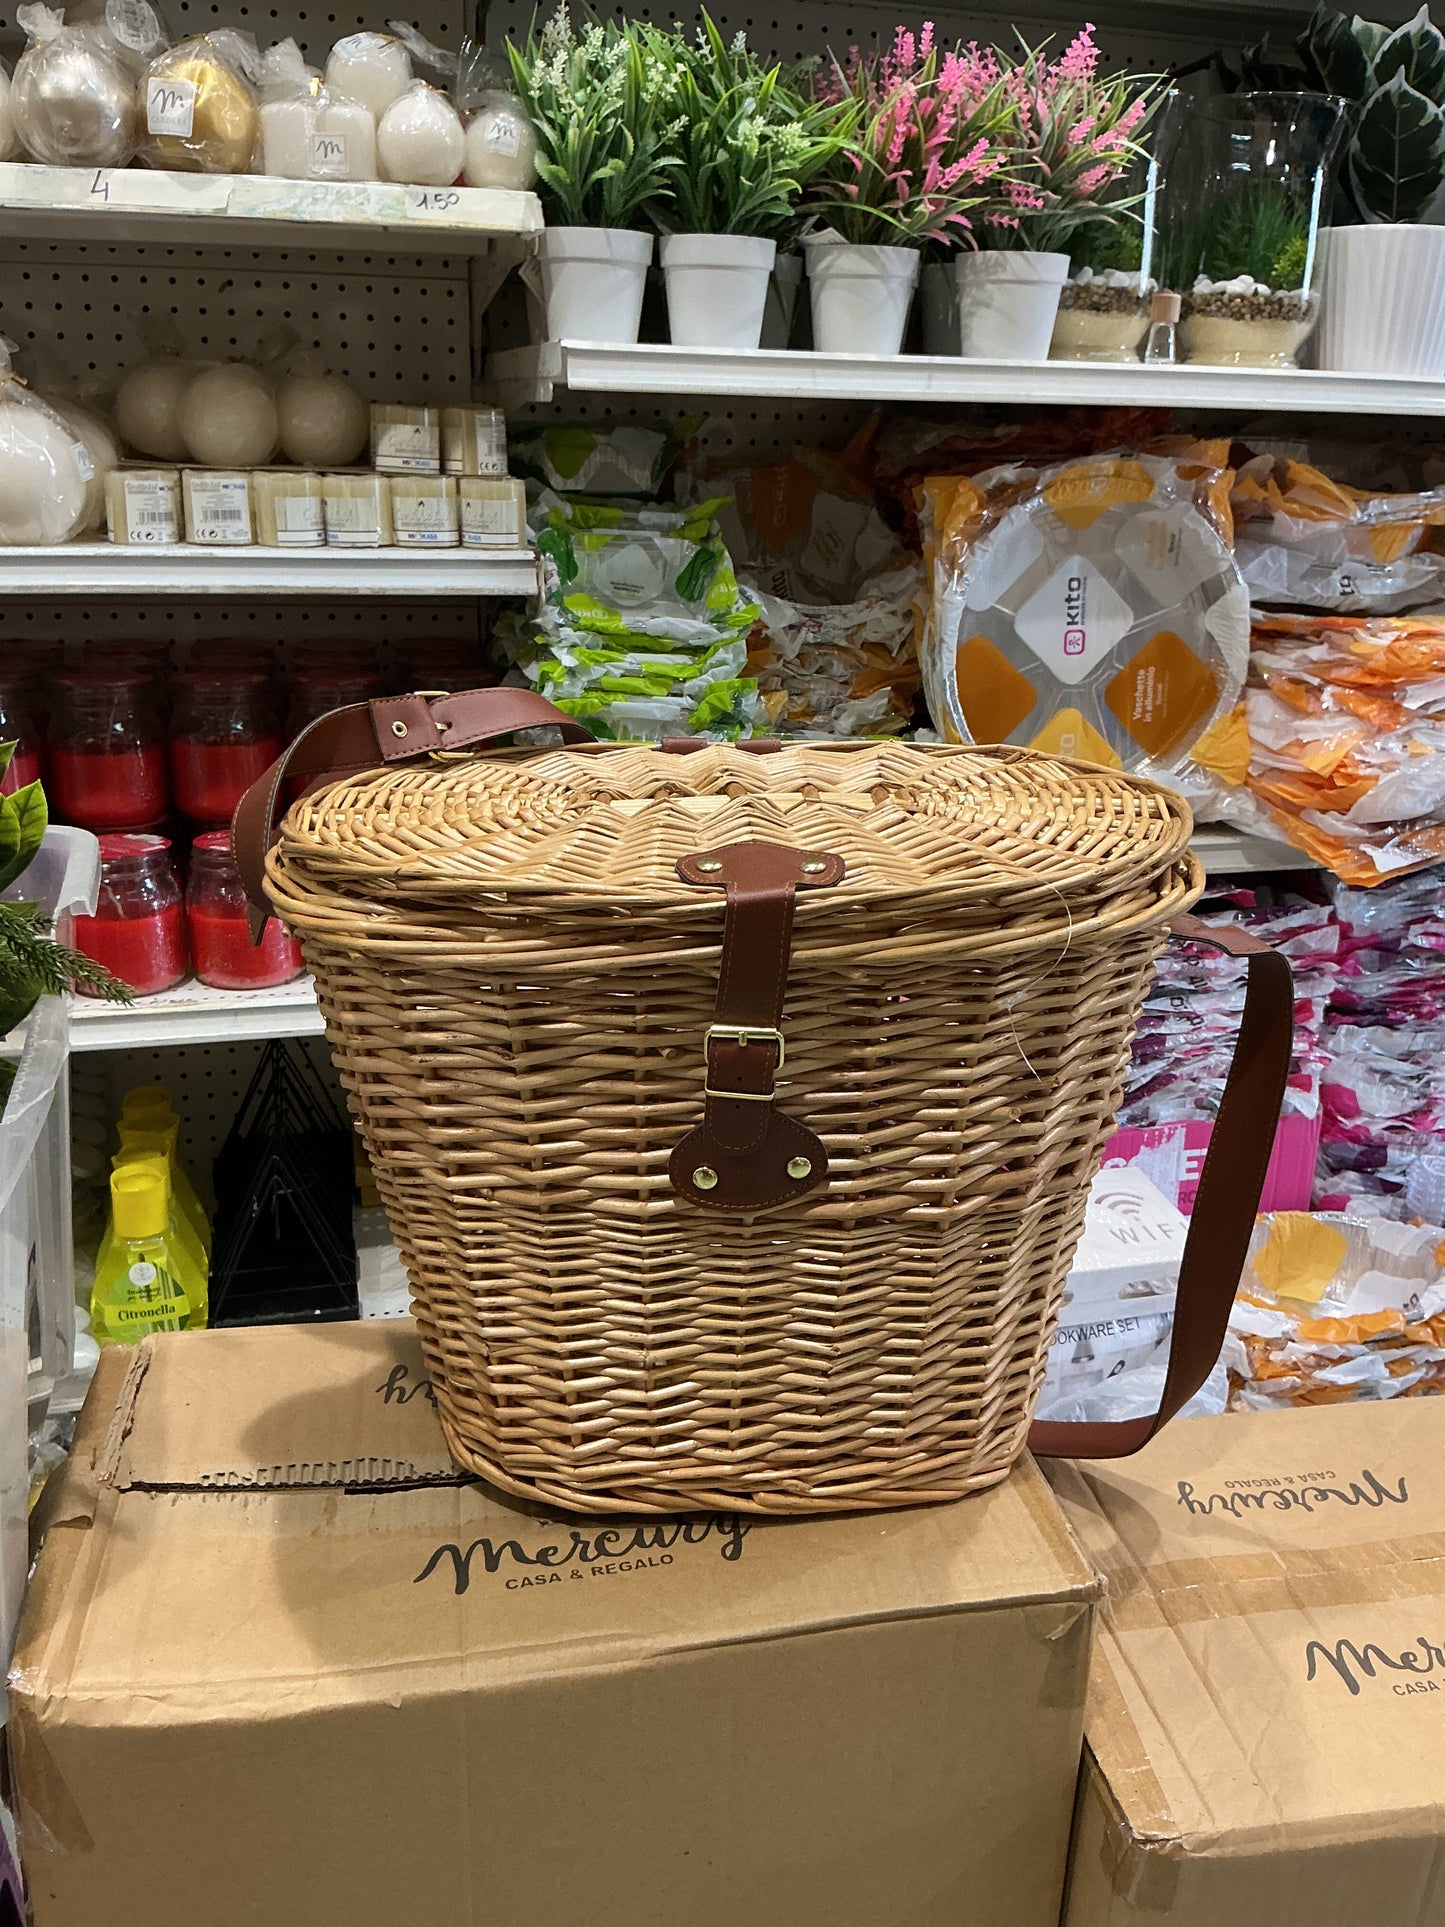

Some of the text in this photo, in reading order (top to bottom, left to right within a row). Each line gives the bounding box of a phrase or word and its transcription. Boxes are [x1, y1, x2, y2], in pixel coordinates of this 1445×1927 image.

[90, 170, 110, 201] 4
[415, 191, 460, 211] 1.50
[1132, 668, 1146, 721] Vaschette
[1142, 666, 1157, 723] in alluminio
[117, 1303, 176, 1322] Citronella
[1116, 1316, 1141, 1334] SET
[1224, 1469, 1337, 1489] CASA & REGALO
[505, 1553, 675, 1591] CASA & REGALO
[1392, 1679, 1441, 1696] CASA
